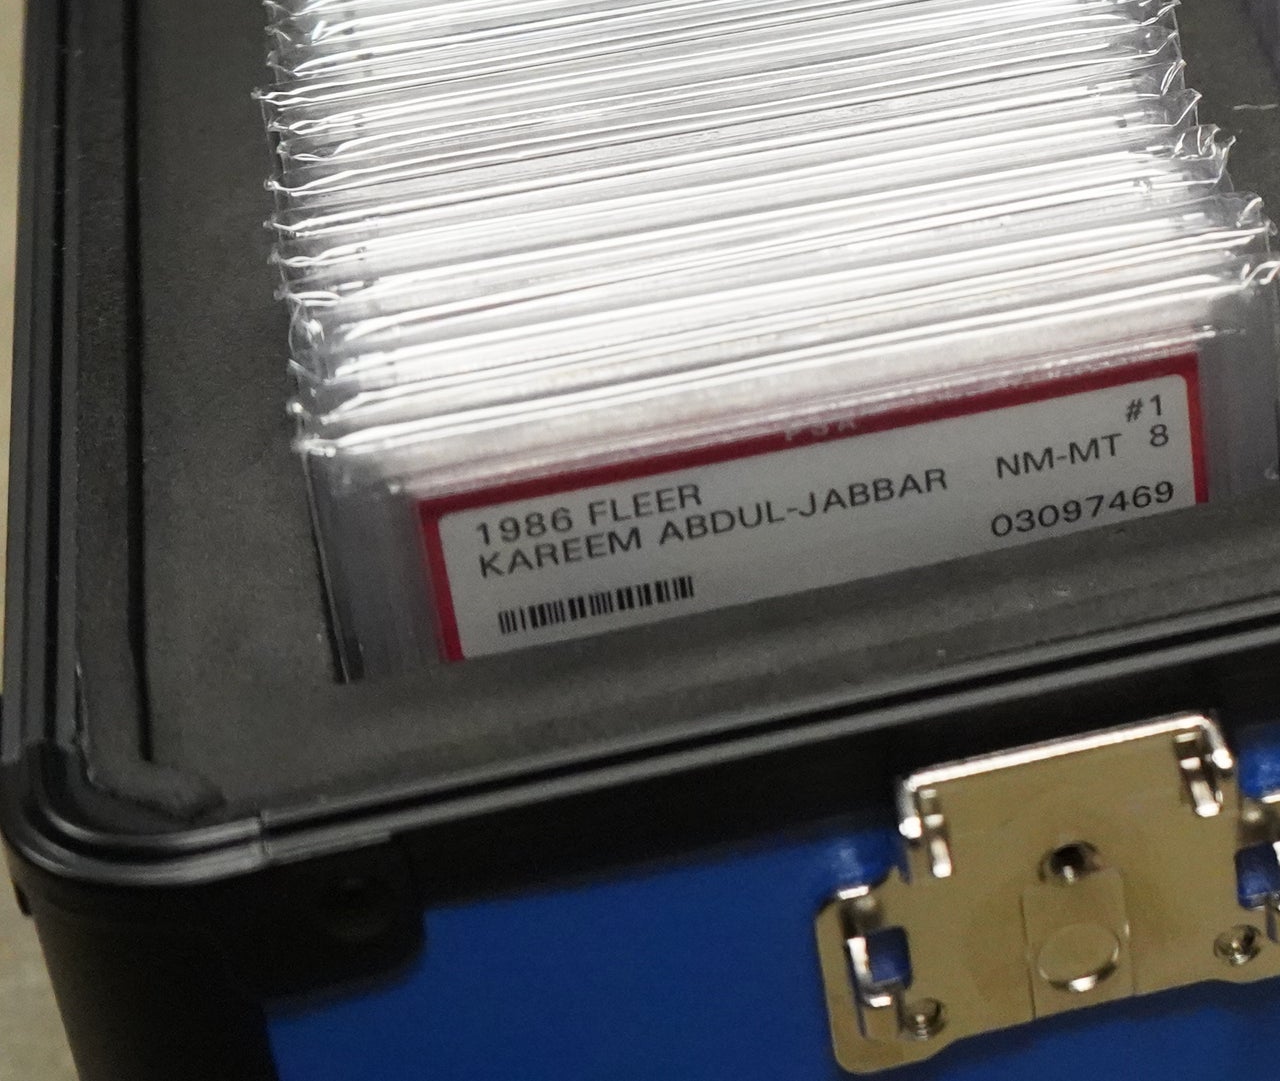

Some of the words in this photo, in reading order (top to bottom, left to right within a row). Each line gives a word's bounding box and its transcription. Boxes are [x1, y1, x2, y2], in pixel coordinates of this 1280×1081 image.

[1124, 393, 1164, 423] #1
[995, 432, 1124, 479] NM-MT
[1148, 423, 1170, 448] 8
[476, 506, 574, 547] 1986
[587, 483, 703, 527] FLEER
[477, 527, 642, 579] KAREEM
[658, 468, 948, 546] ABDUL-JABBAR
[990, 480, 1175, 538] 03097469
